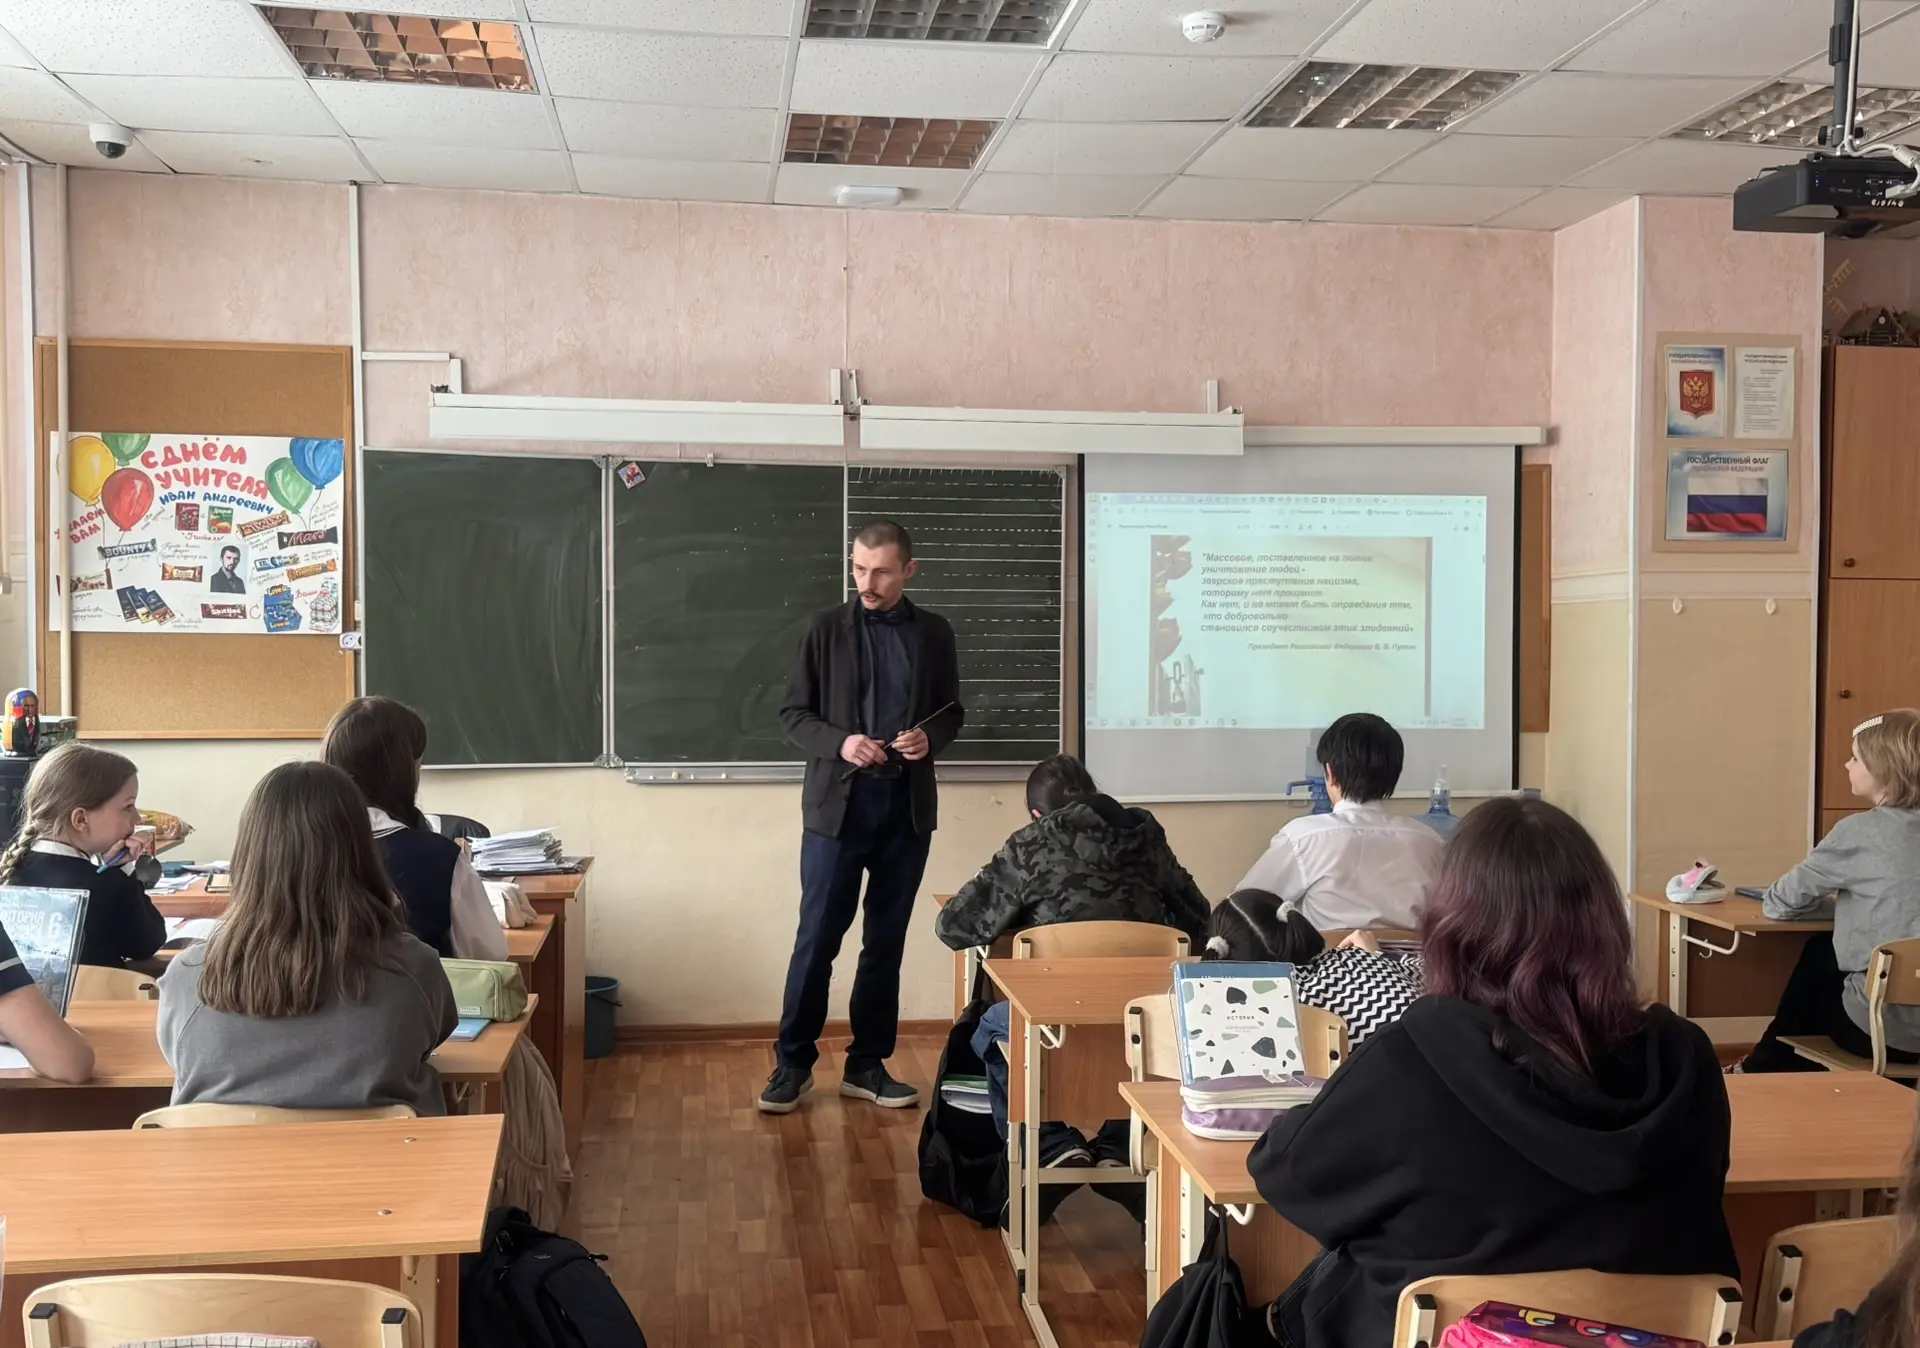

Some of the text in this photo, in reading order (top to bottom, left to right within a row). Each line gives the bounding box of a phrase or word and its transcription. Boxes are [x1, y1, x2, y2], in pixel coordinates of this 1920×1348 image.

[159, 490, 274, 514] ИВАН АНДРЕЕВИЧ
[70, 523, 101, 544] ВАМ
[105, 543, 147, 557] BOUNTY
[1201, 600, 1218, 608] Как
[0, 909, 45, 923] СТОРИЯ
